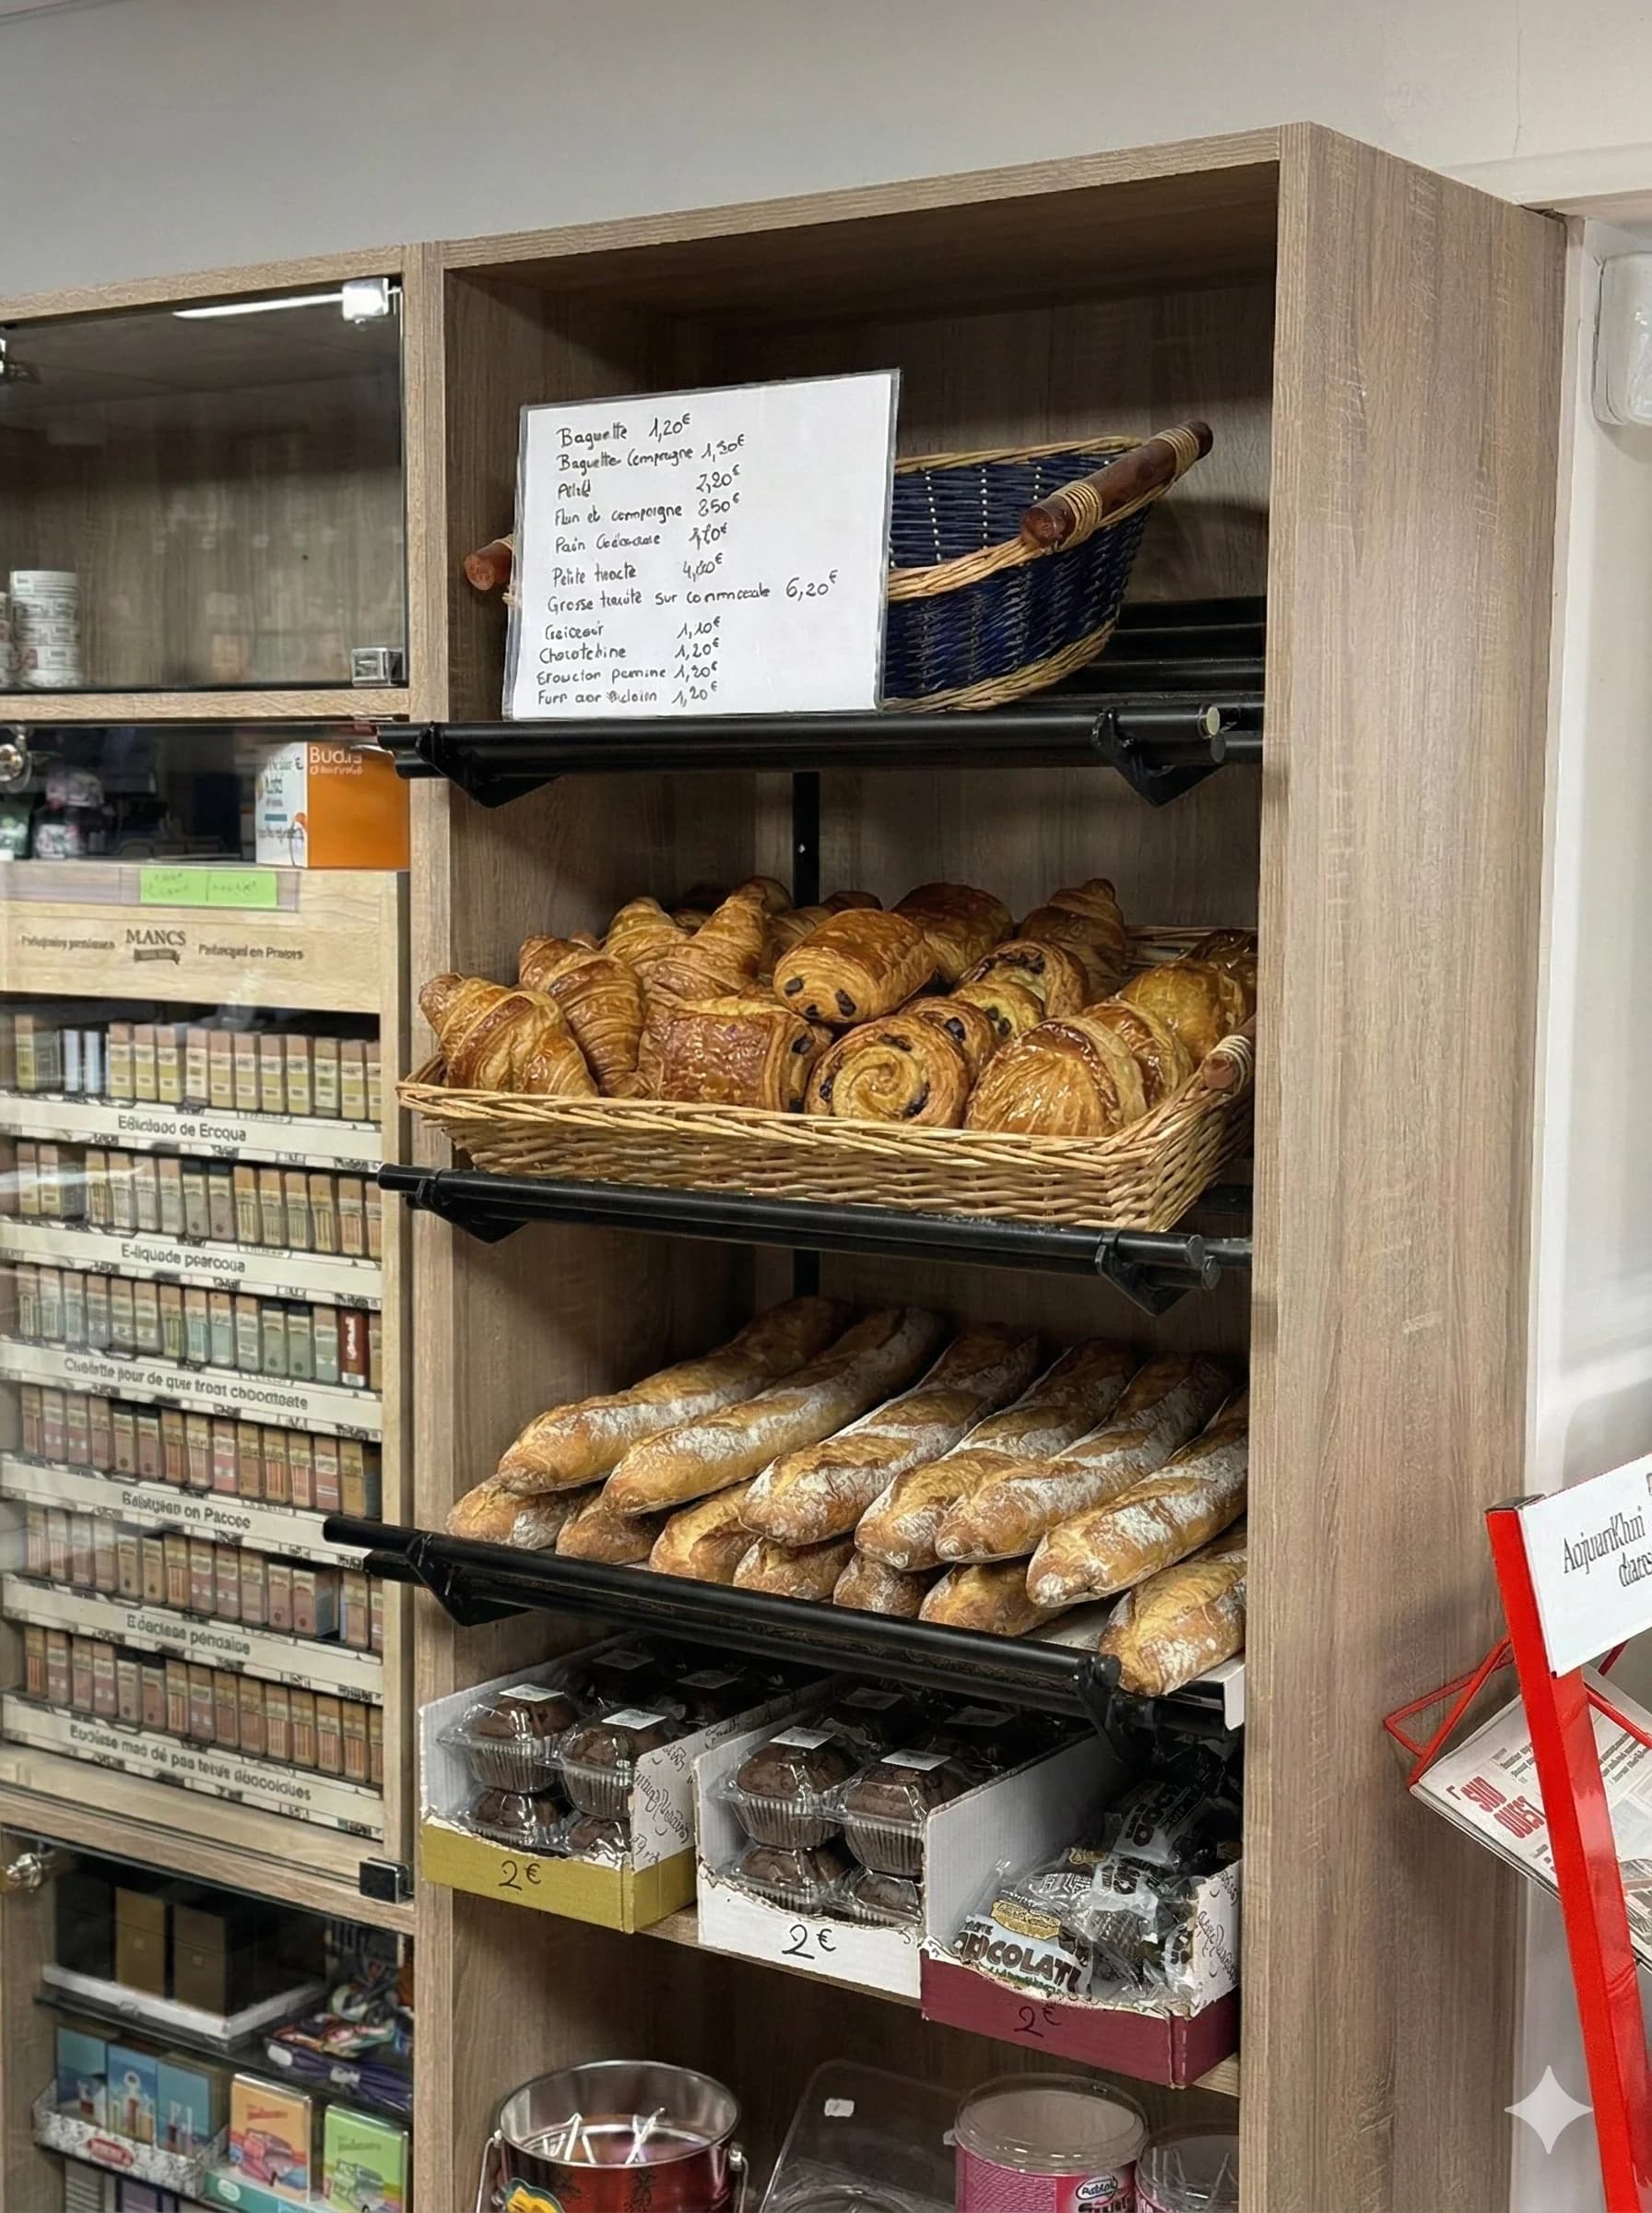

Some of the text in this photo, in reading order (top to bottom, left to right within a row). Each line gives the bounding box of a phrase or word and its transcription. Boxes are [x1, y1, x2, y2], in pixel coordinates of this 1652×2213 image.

[555, 420, 628, 450] Baguette
[556, 451, 621, 476] Baguette
[554, 536, 586, 553] Pain
[785, 569, 838, 601] 6,20€
[126, 929, 186, 948] MANCS
